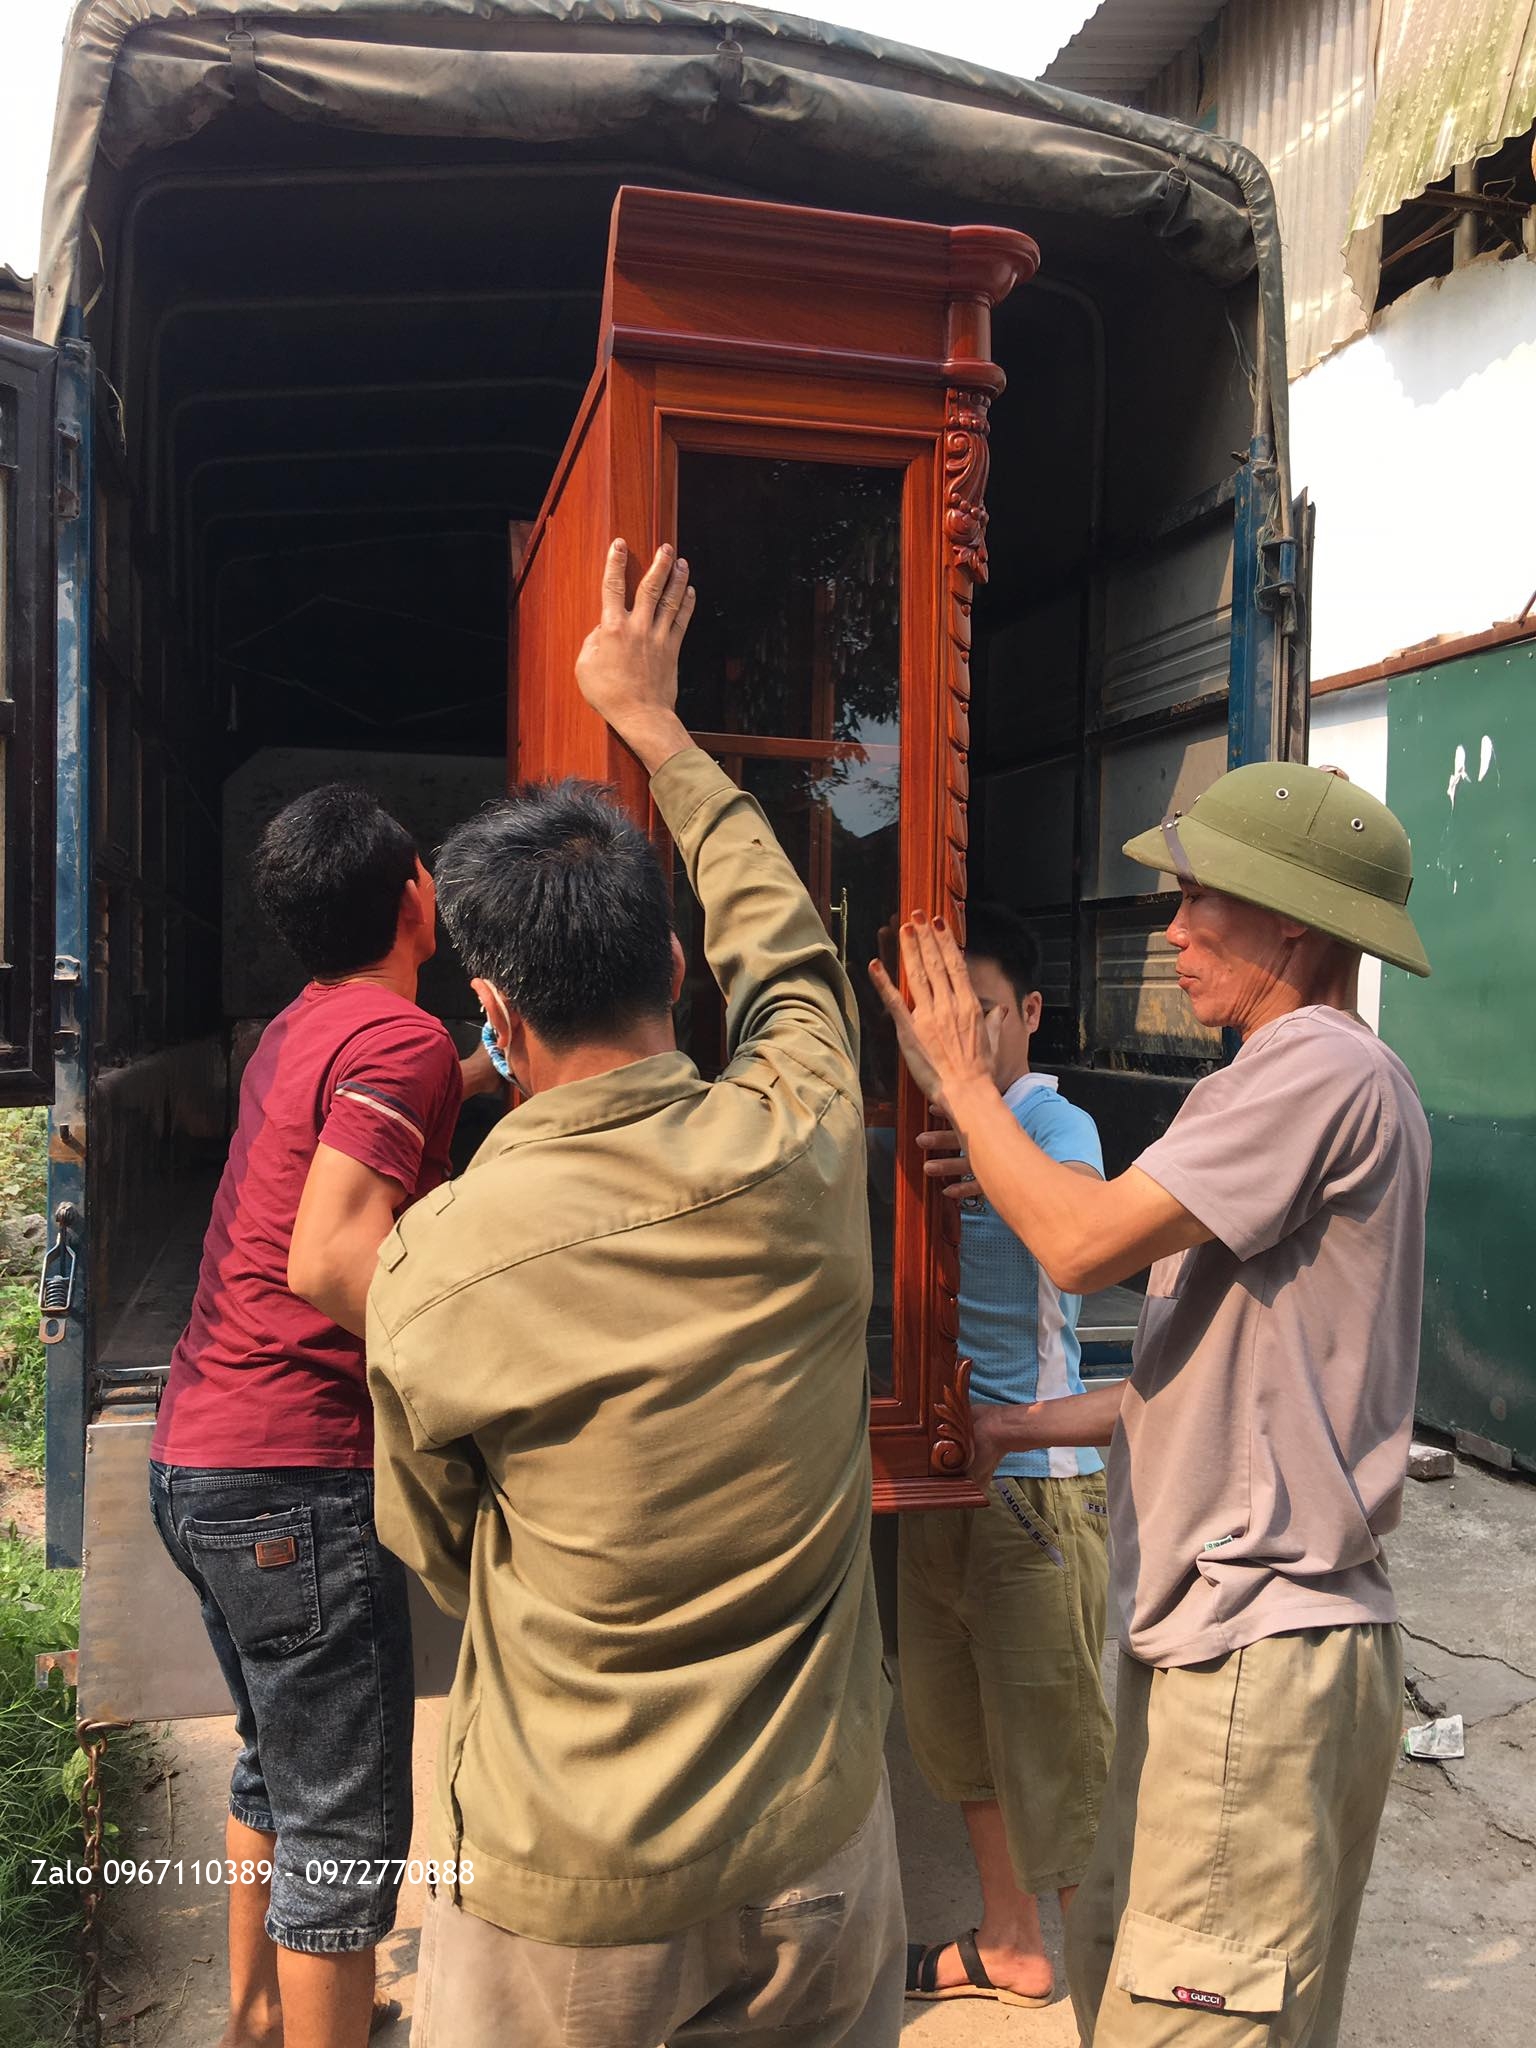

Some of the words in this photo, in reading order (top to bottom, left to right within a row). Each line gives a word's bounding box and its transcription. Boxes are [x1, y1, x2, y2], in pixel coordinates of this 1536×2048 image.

[1002, 1488, 1032, 1530] SPORT
[1031, 1531, 1049, 1548] FS
[1190, 1992, 1220, 2005] GUCCI
